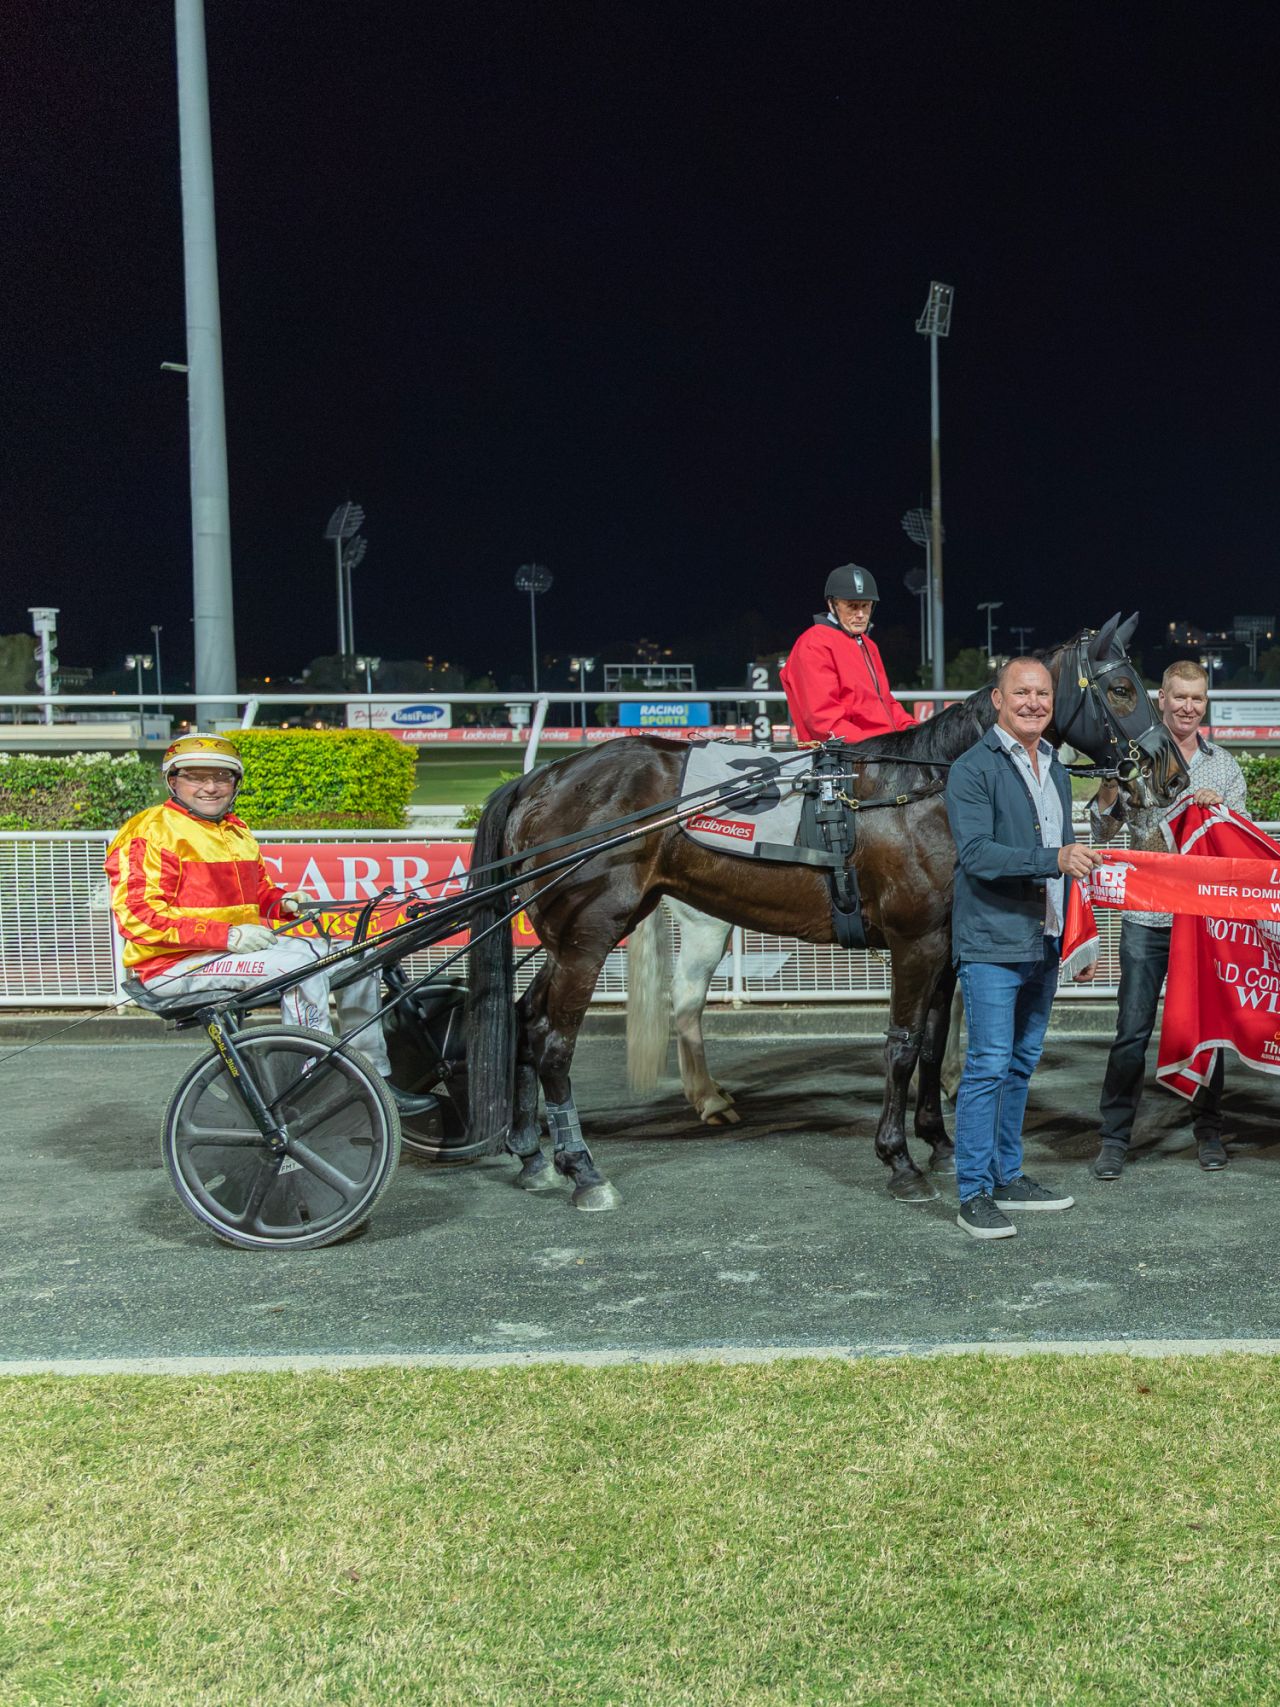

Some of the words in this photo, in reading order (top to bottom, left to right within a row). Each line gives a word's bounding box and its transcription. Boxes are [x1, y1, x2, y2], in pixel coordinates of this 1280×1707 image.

[752, 667, 769, 690] 2
[640, 705, 684, 716] RACING
[640, 716, 687, 726] SPORTS
[754, 716, 771, 739] 3
[402, 730, 448, 740] Ladbrokes
[462, 730, 508, 740] Ladbrokes
[719, 756, 781, 815] 3
[689, 815, 752, 838] Ladbrokes
[1198, 884, 1238, 897] INTER
[202, 961, 232, 974] DAVID
[236, 961, 265, 974] MILES
